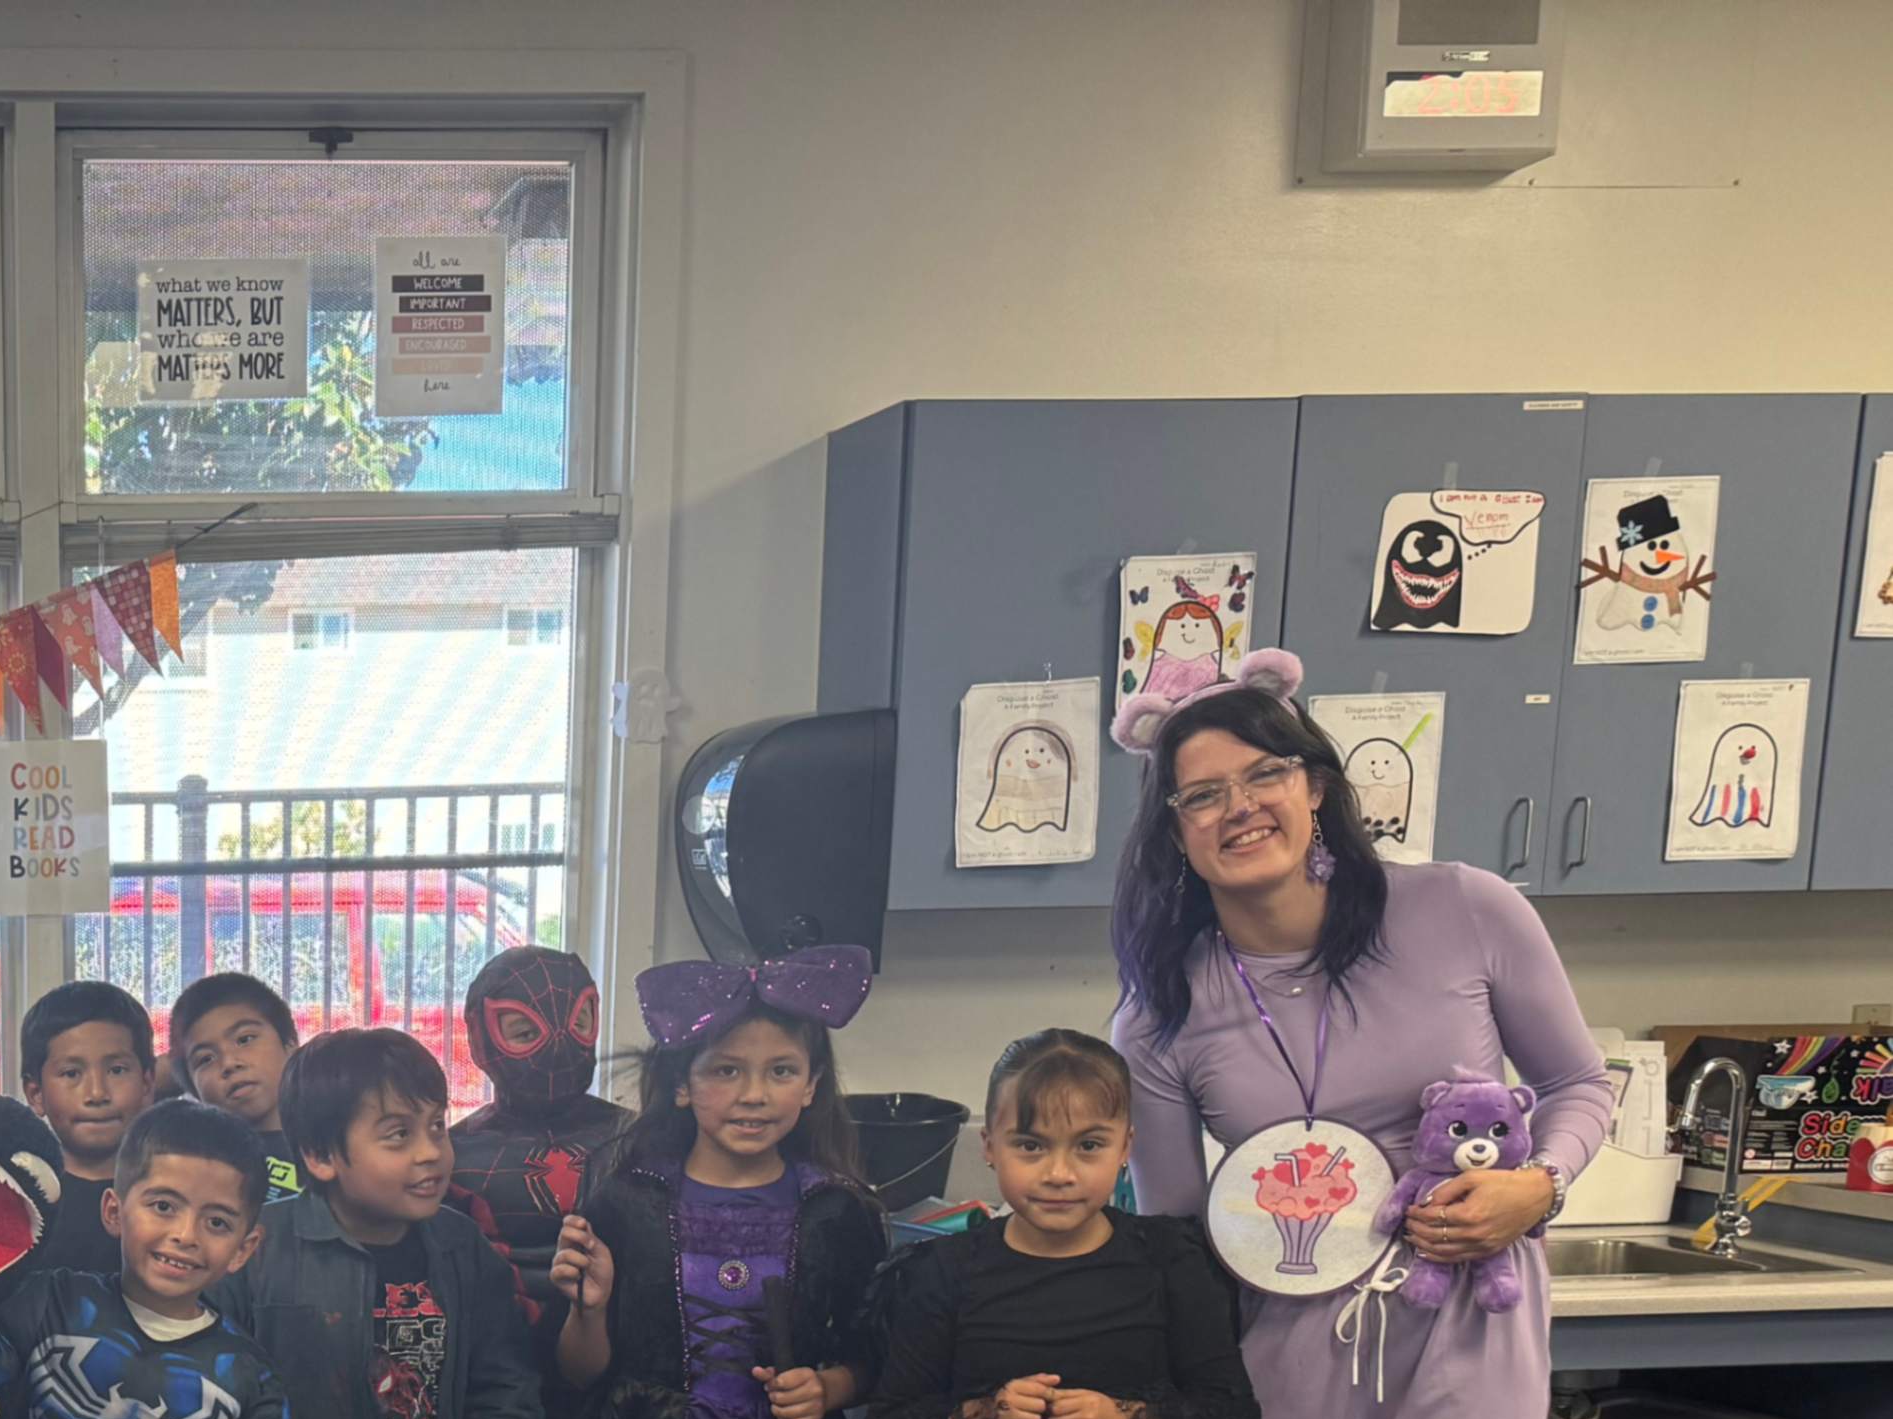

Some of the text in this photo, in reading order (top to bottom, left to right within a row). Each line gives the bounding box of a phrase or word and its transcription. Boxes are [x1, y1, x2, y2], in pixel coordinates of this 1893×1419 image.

[412, 251, 461, 269] all are
[156, 276, 284, 294] what we know
[413, 277, 463, 290] WELCOME
[157, 296, 284, 328] MATTERS, BUT
[409, 297, 466, 310] IMPORTANT
[411, 318, 465, 330] RESPECTED
[247, 331, 284, 347] are
[239, 352, 285, 380] MORE
[424, 378, 450, 393] here
[11, 762, 73, 790] COOL
[14, 793, 74, 821] KIDS
[14, 826, 75, 851] READ
[10, 855, 81, 879] BOOKS
[1801, 1111, 1861, 1136] Side
[1796, 1137, 1849, 1159] Cha
